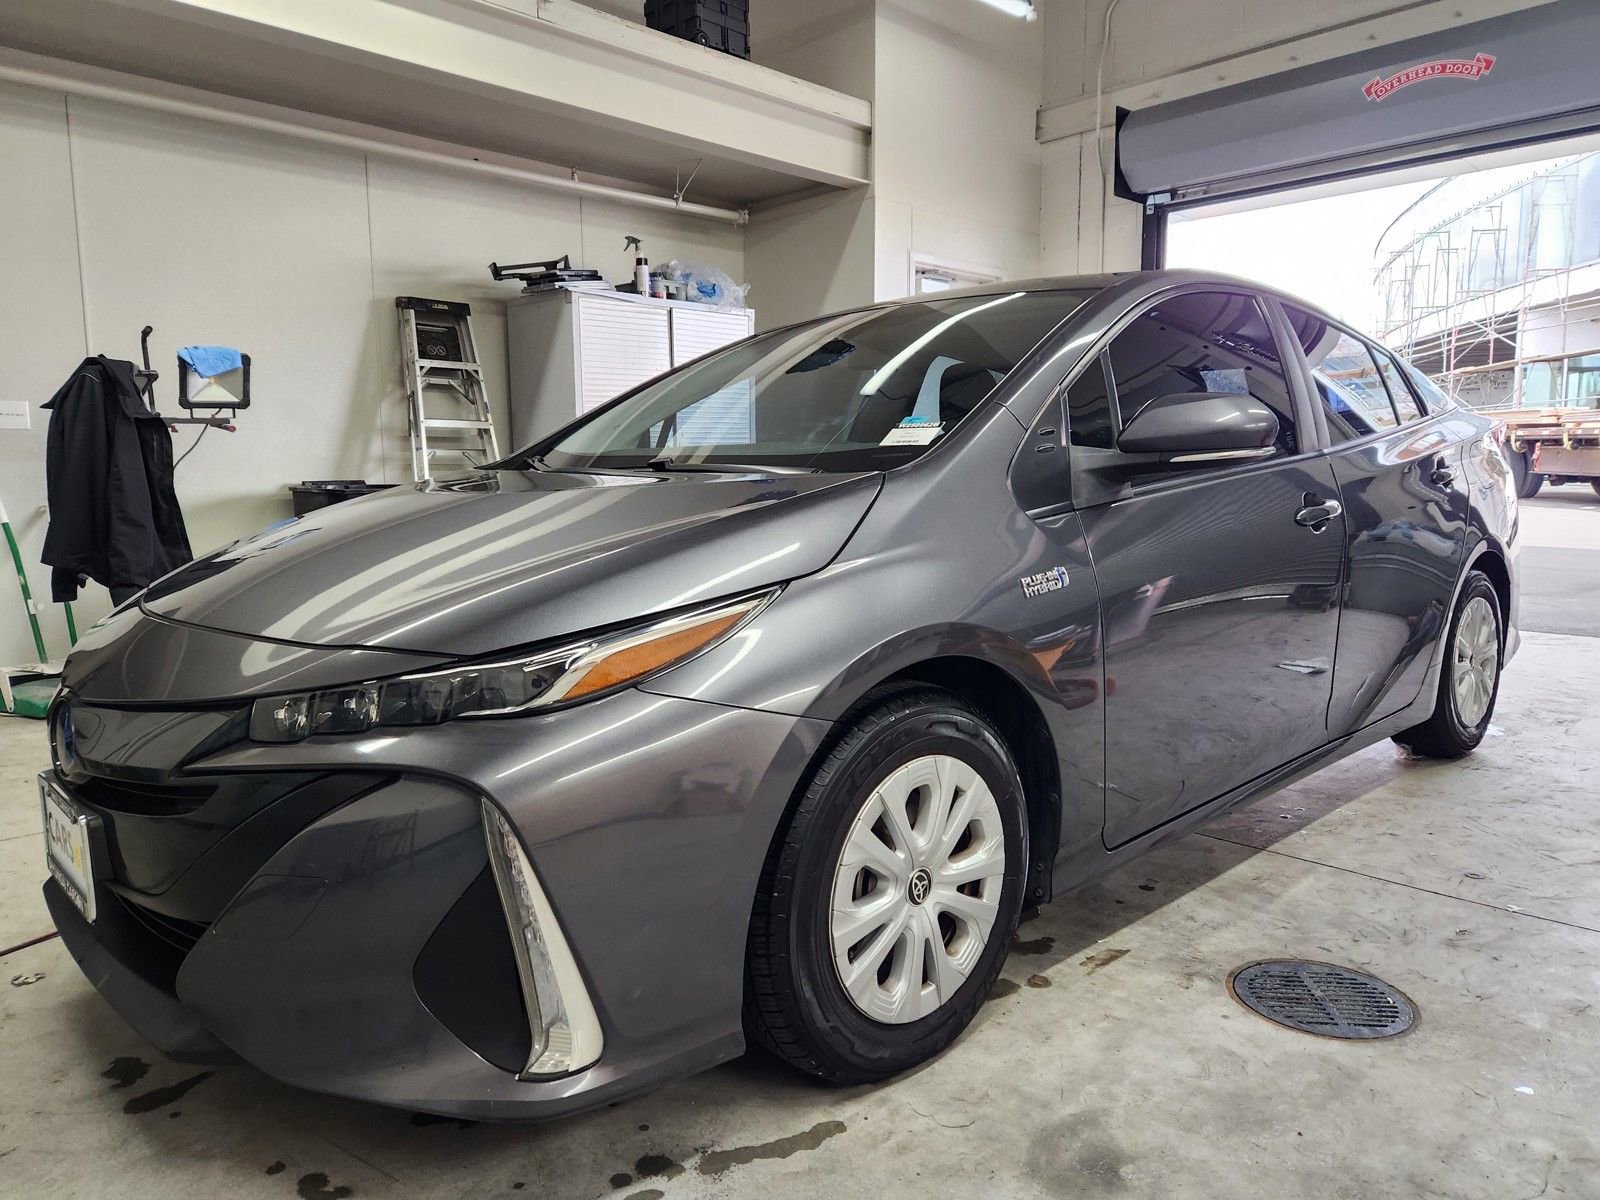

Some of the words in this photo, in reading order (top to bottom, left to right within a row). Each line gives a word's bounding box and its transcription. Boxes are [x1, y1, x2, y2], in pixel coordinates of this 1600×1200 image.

[1377, 65, 1442, 96] OVERHEAD
[1445, 64, 1478, 76] DOOR
[1021, 569, 1058, 586] PLUG-IN
[1024, 580, 1059, 598] HYBRID
